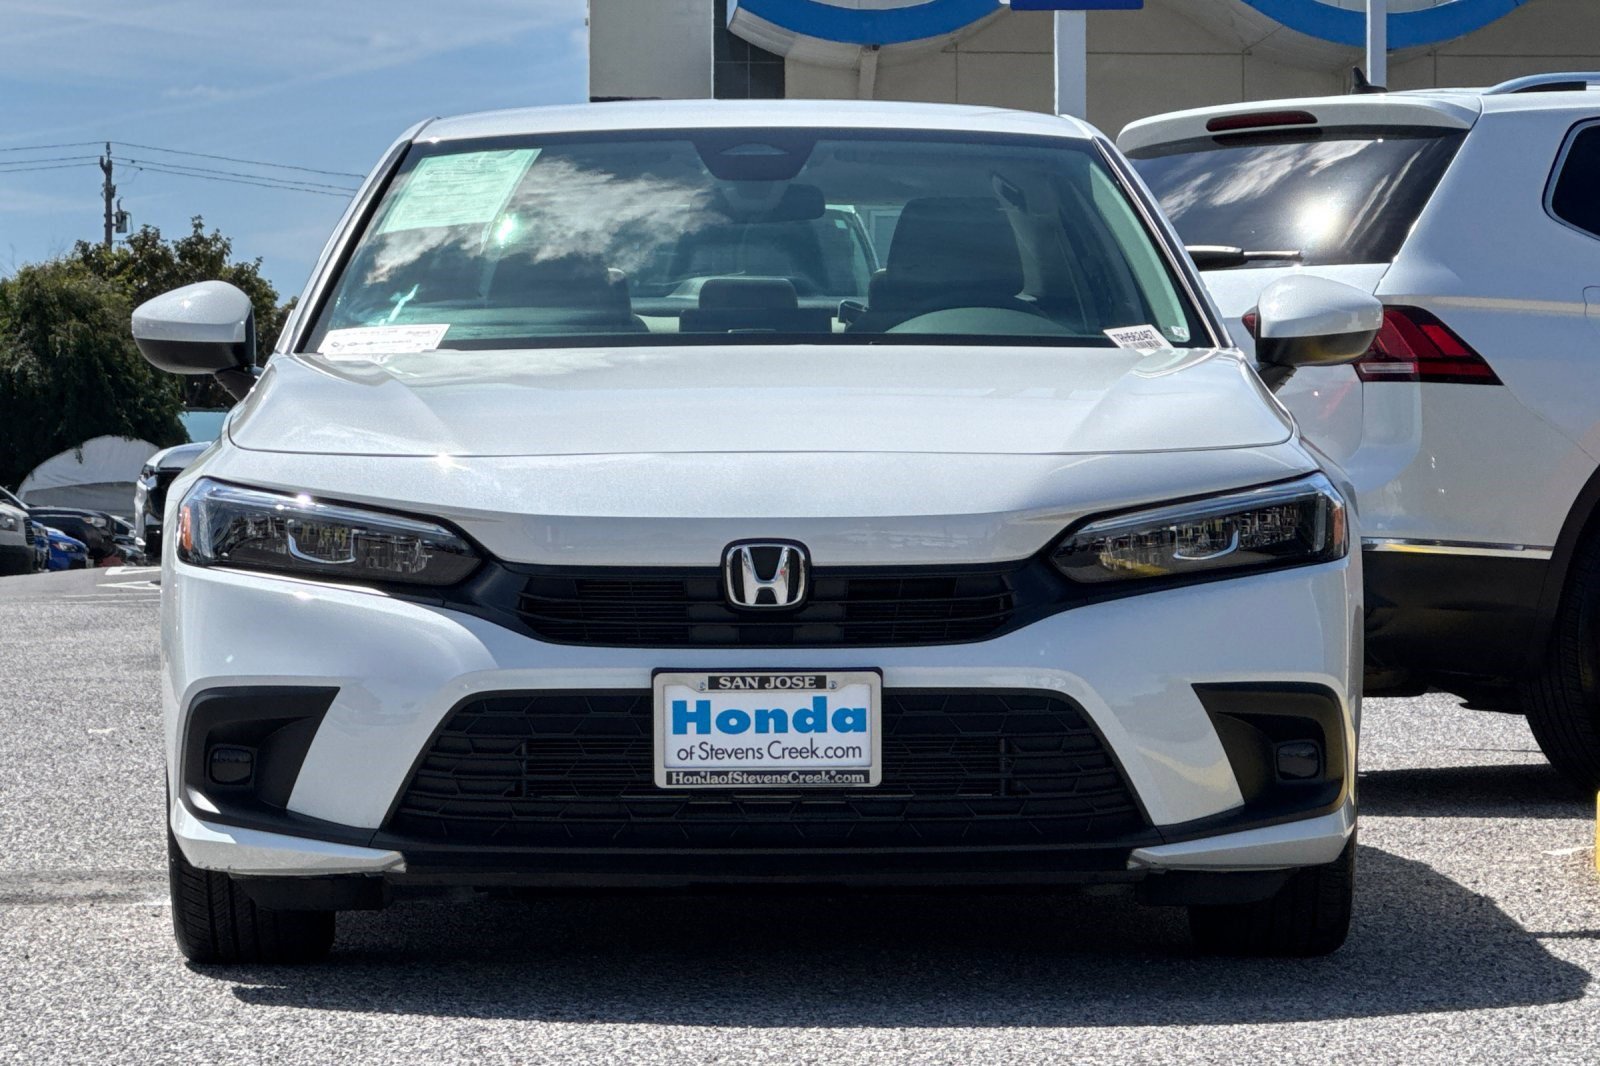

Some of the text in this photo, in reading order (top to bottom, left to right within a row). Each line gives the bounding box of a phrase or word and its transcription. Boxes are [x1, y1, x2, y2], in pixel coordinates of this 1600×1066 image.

[718, 676, 817, 690] SAN JOSE
[671, 695, 867, 735] Honda
[676, 737, 862, 761] of Stevens Creek.com
[671, 770, 865, 785] HondaofStevensCreek.com
